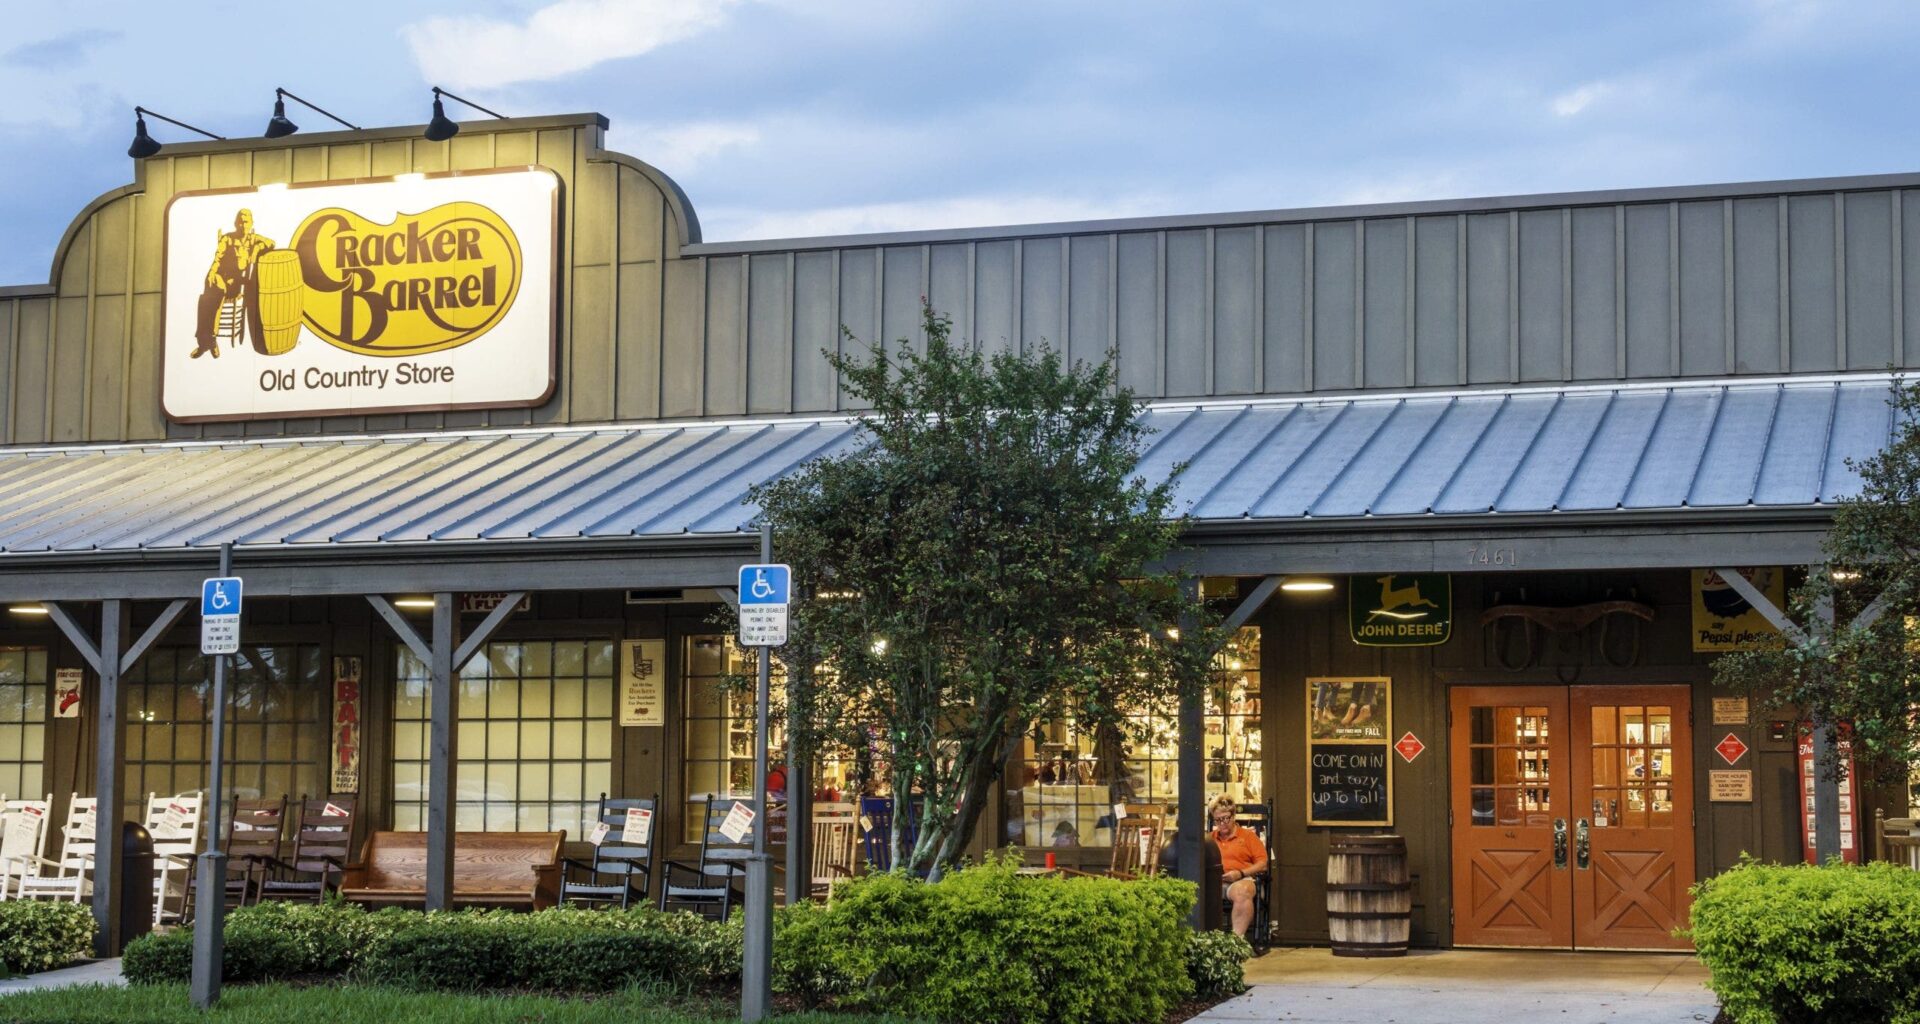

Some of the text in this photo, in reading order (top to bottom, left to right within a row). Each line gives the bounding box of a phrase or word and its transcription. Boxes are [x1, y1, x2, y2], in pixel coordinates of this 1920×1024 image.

[297, 213, 484, 293] Cracker
[340, 265, 497, 347] Barrel
[259, 362, 455, 391] Old Country Store
[1469, 548, 1518, 566] 7461
[1358, 623, 1443, 637] JOHN DEERE
[1711, 622, 1725, 630] say
[337, 681, 358, 767] BAIT
[1365, 727, 1380, 736] FALL
[1312, 754, 1347, 768] COME
[1350, 754, 1367, 768] ON
[1320, 773, 1378, 789] and cozy
